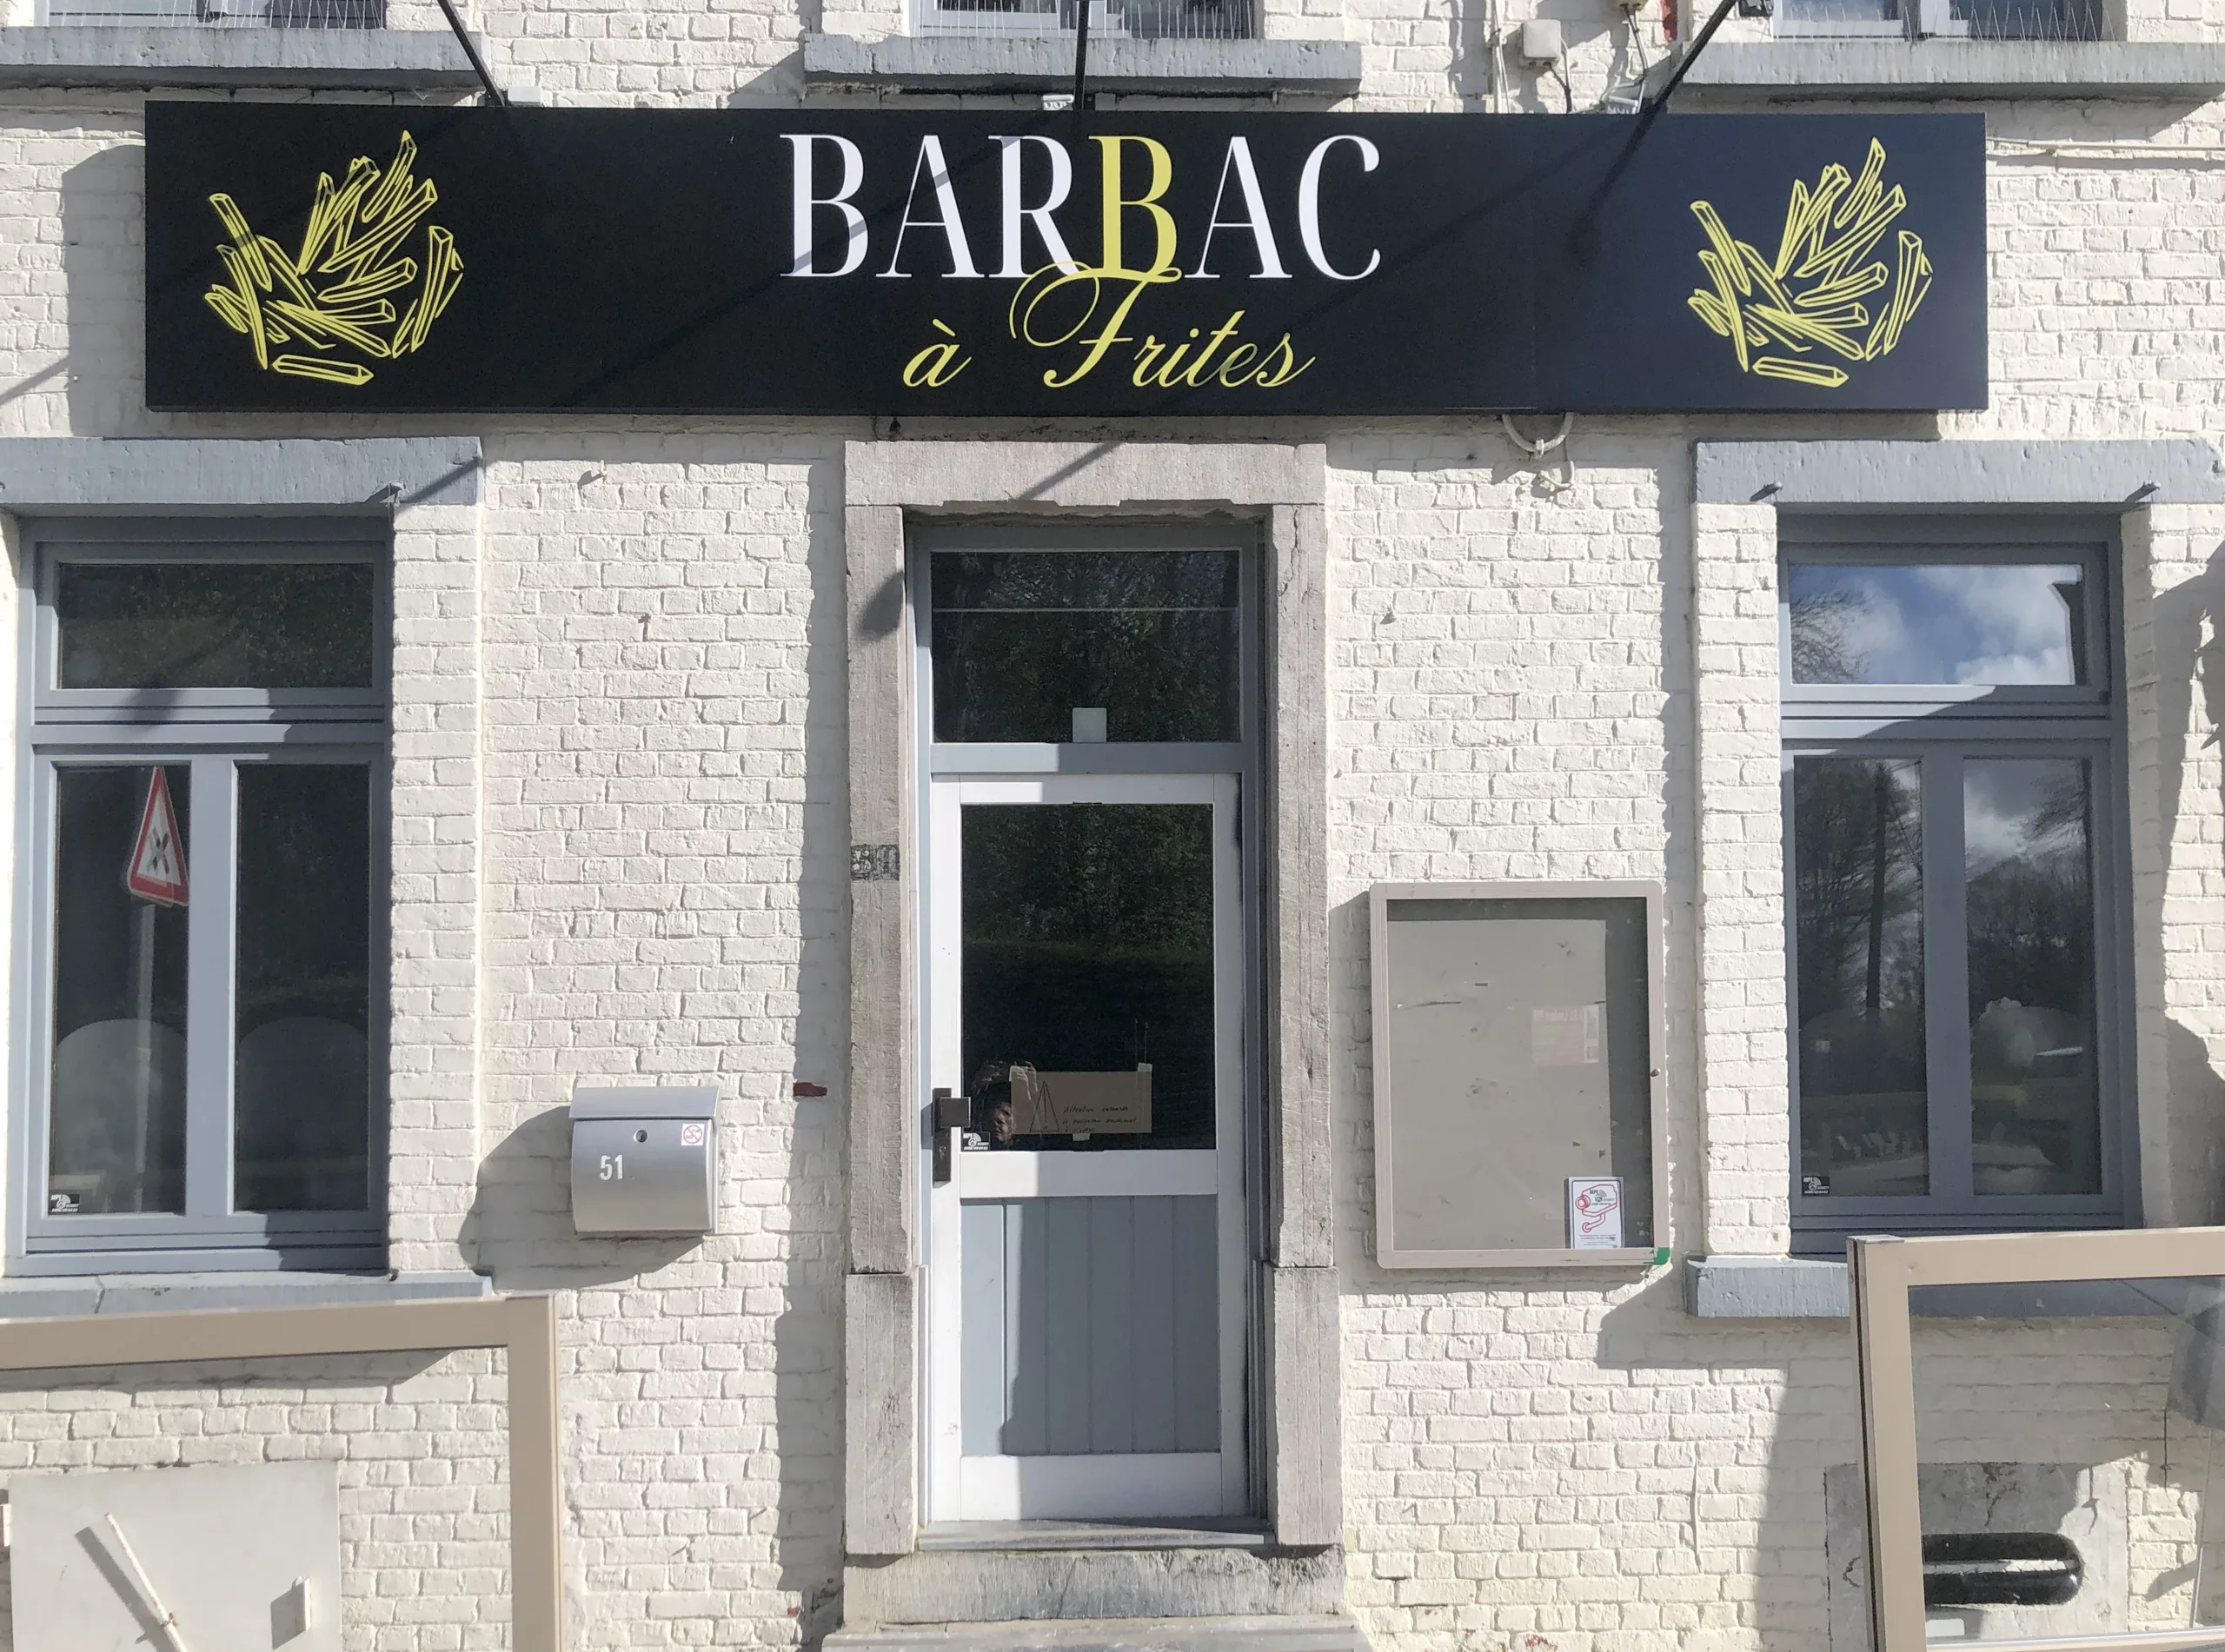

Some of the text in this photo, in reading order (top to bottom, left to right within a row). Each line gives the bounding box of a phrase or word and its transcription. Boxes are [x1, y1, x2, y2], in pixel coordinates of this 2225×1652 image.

[780, 134, 1380, 280] BARBAC
[903, 261, 1316, 388] à Frites
[600, 1154, 623, 1180] 51
